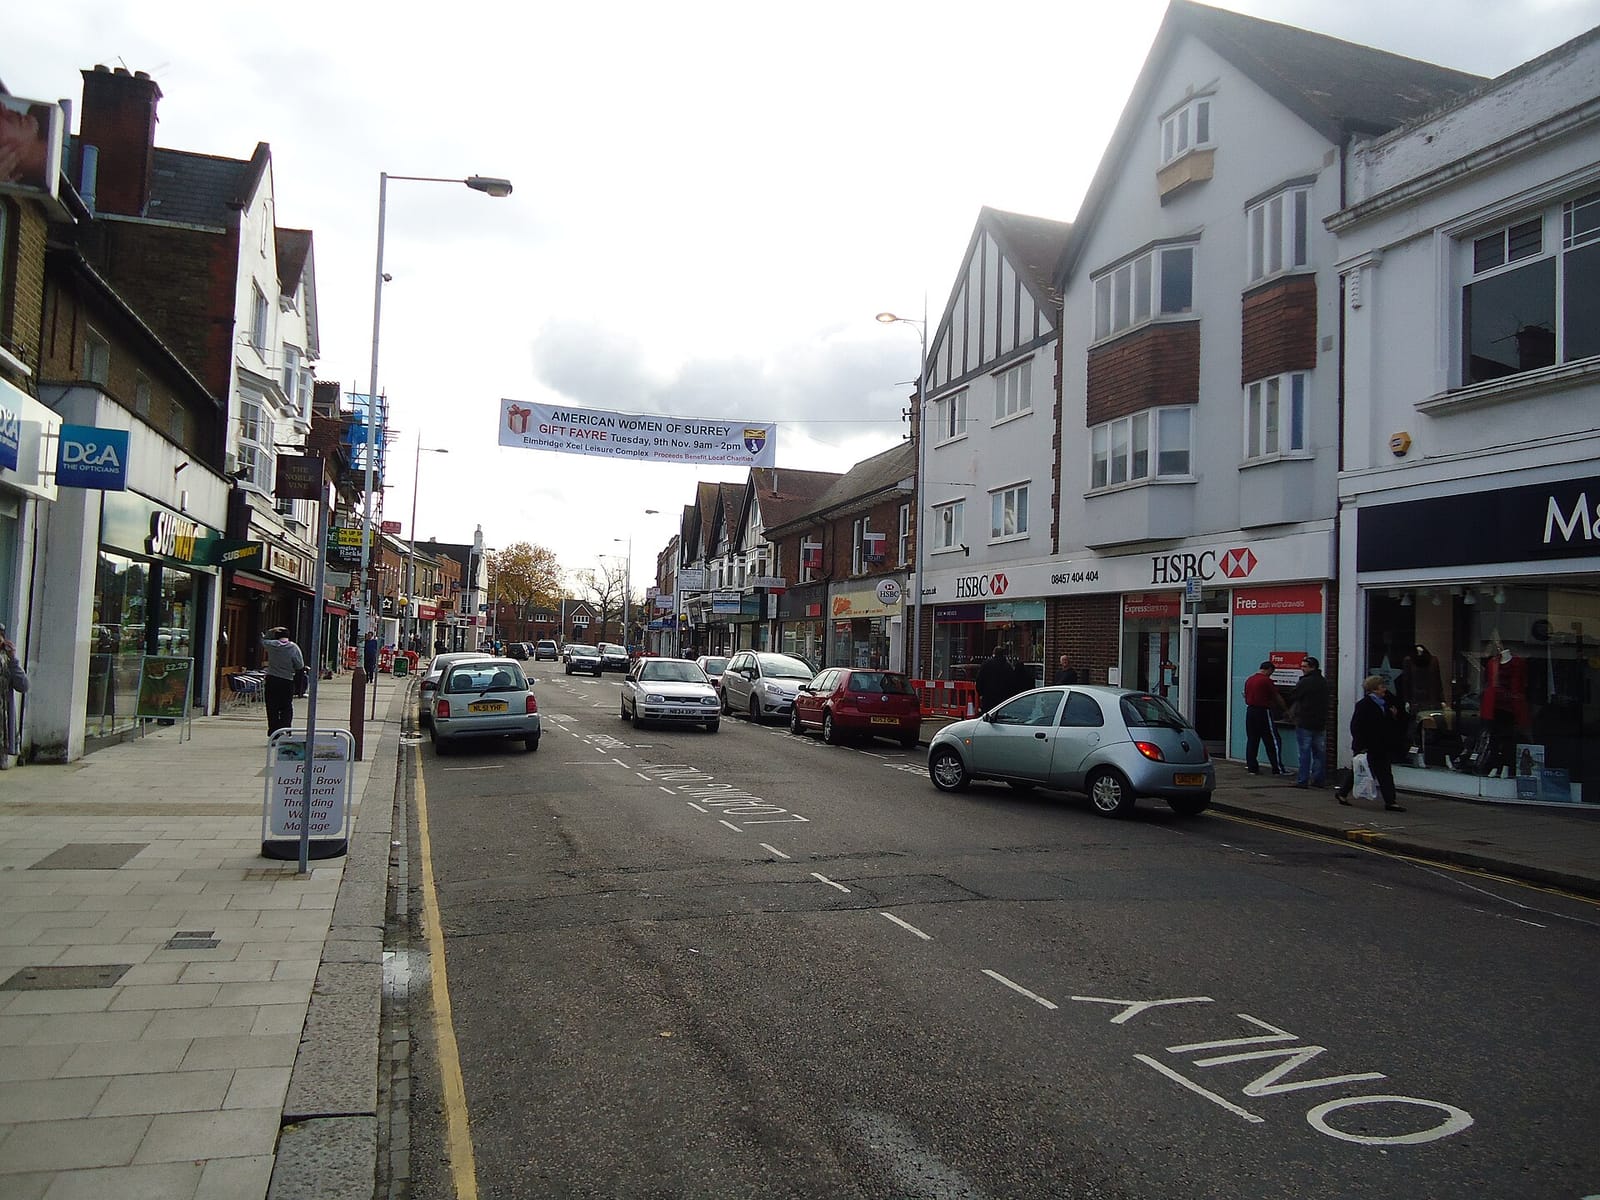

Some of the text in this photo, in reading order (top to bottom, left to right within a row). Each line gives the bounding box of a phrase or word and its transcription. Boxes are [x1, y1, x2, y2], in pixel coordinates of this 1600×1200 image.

[551, 411, 731, 436] AMERICAN WOMEN OF SURREY
[539, 424, 566, 436] GIFT
[569, 428, 607, 440] FAYRE
[611, 434, 650, 446] Tuesday,
[653, 438, 668, 447] 9th
[671, 439, 690, 448] Nov.
[693, 441, 712, 449] 9am
[721, 442, 740, 451] 2pm
[62, 441, 119, 467] D&A
[523, 437, 563, 448] Elmbridge
[585, 445, 613, 453] Leisure
[615, 448, 649, 457] Complex
[653, 451, 683, 459] Proceeds
[79, 465, 120, 474] OPTICIANS
[1543, 492, 1600, 543] M
[151, 511, 198, 562] SUBWAY
[221, 547, 258, 562] SUBWAY
[1151, 550, 1216, 584] HSBC
[956, 575, 989, 598] HSBC
[1051, 574, 1070, 585] 08457
[1071, 572, 1084, 583] 404
[1085, 571, 1099, 582] 404
[879, 590, 899, 598] HSBC
[1236, 597, 1257, 609] Free
[1271, 600, 1304, 608] withdrawals
[1271, 654, 1284, 662] Free
[295, 765, 327, 774] Faial
[277, 776, 342, 785] Lash Brow
[284, 787, 335, 795] Treament
[283, 798, 334, 808] Threding
[288, 810, 327, 820] Waing
[283, 822, 330, 832] Maage
[1071, 995, 1474, 1145] ONLY
